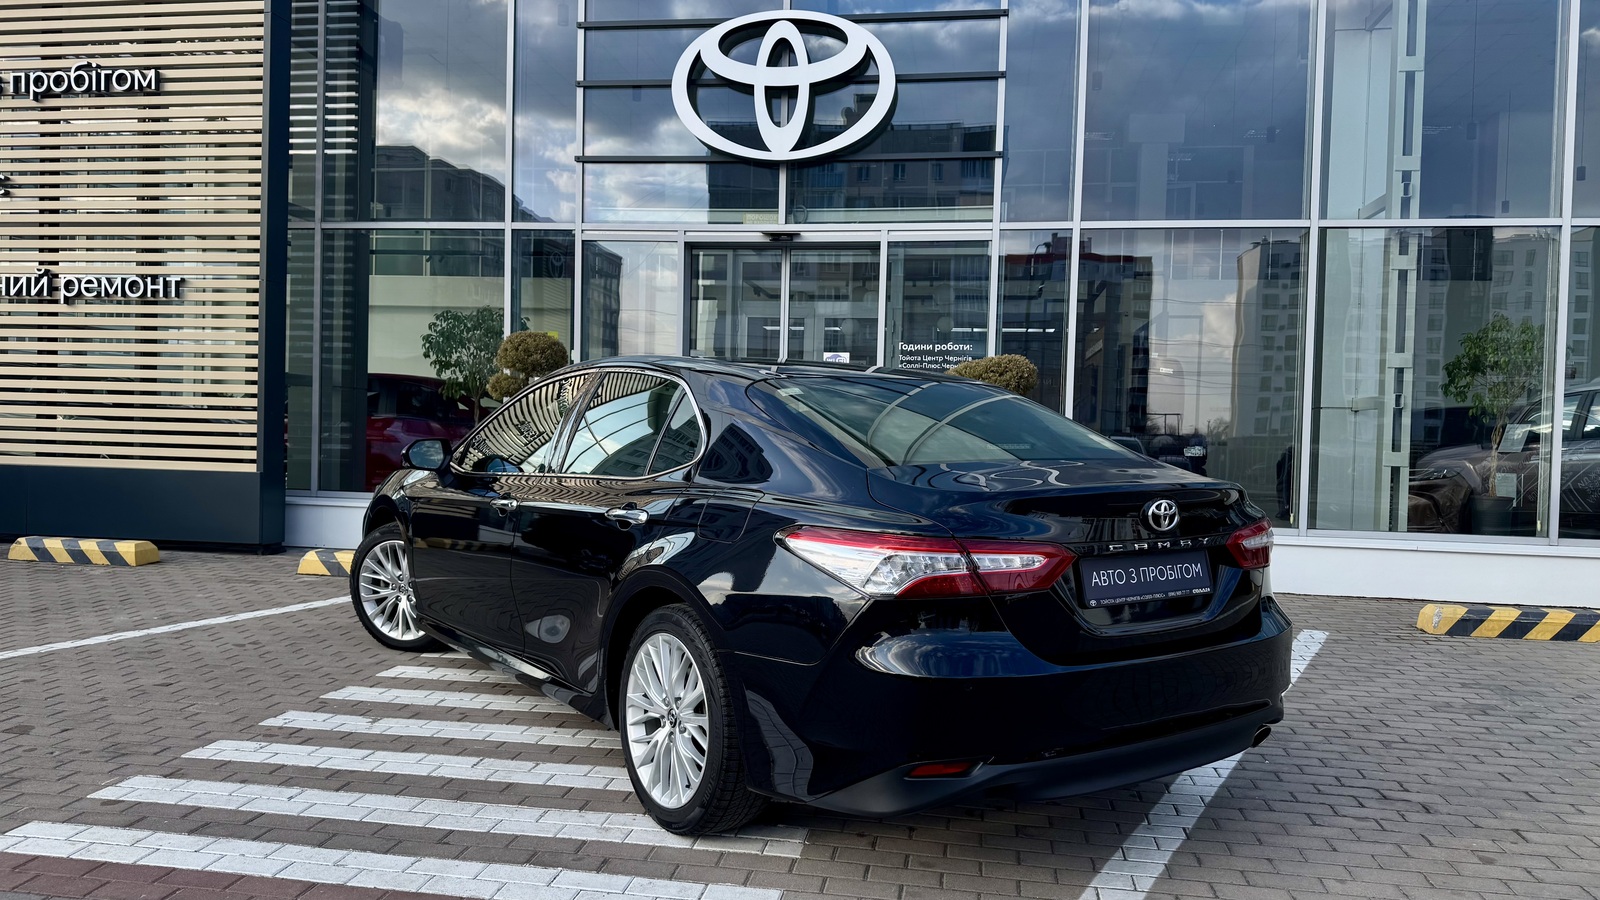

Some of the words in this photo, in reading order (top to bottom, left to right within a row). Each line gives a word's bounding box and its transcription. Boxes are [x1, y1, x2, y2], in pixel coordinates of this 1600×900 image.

[10, 61, 157, 100] пробігом
[60, 275, 183, 304] ремонт
[898, 342, 933, 352] Години
[935, 342, 973, 353] роботи:
[899, 354, 922, 362] Тойота
[922, 354, 944, 363] Центр
[1109, 537, 1209, 552] CAMRY
[1091, 569, 1126, 587] АВТО
[1139, 562, 1203, 583] ПРОБІГОМ
